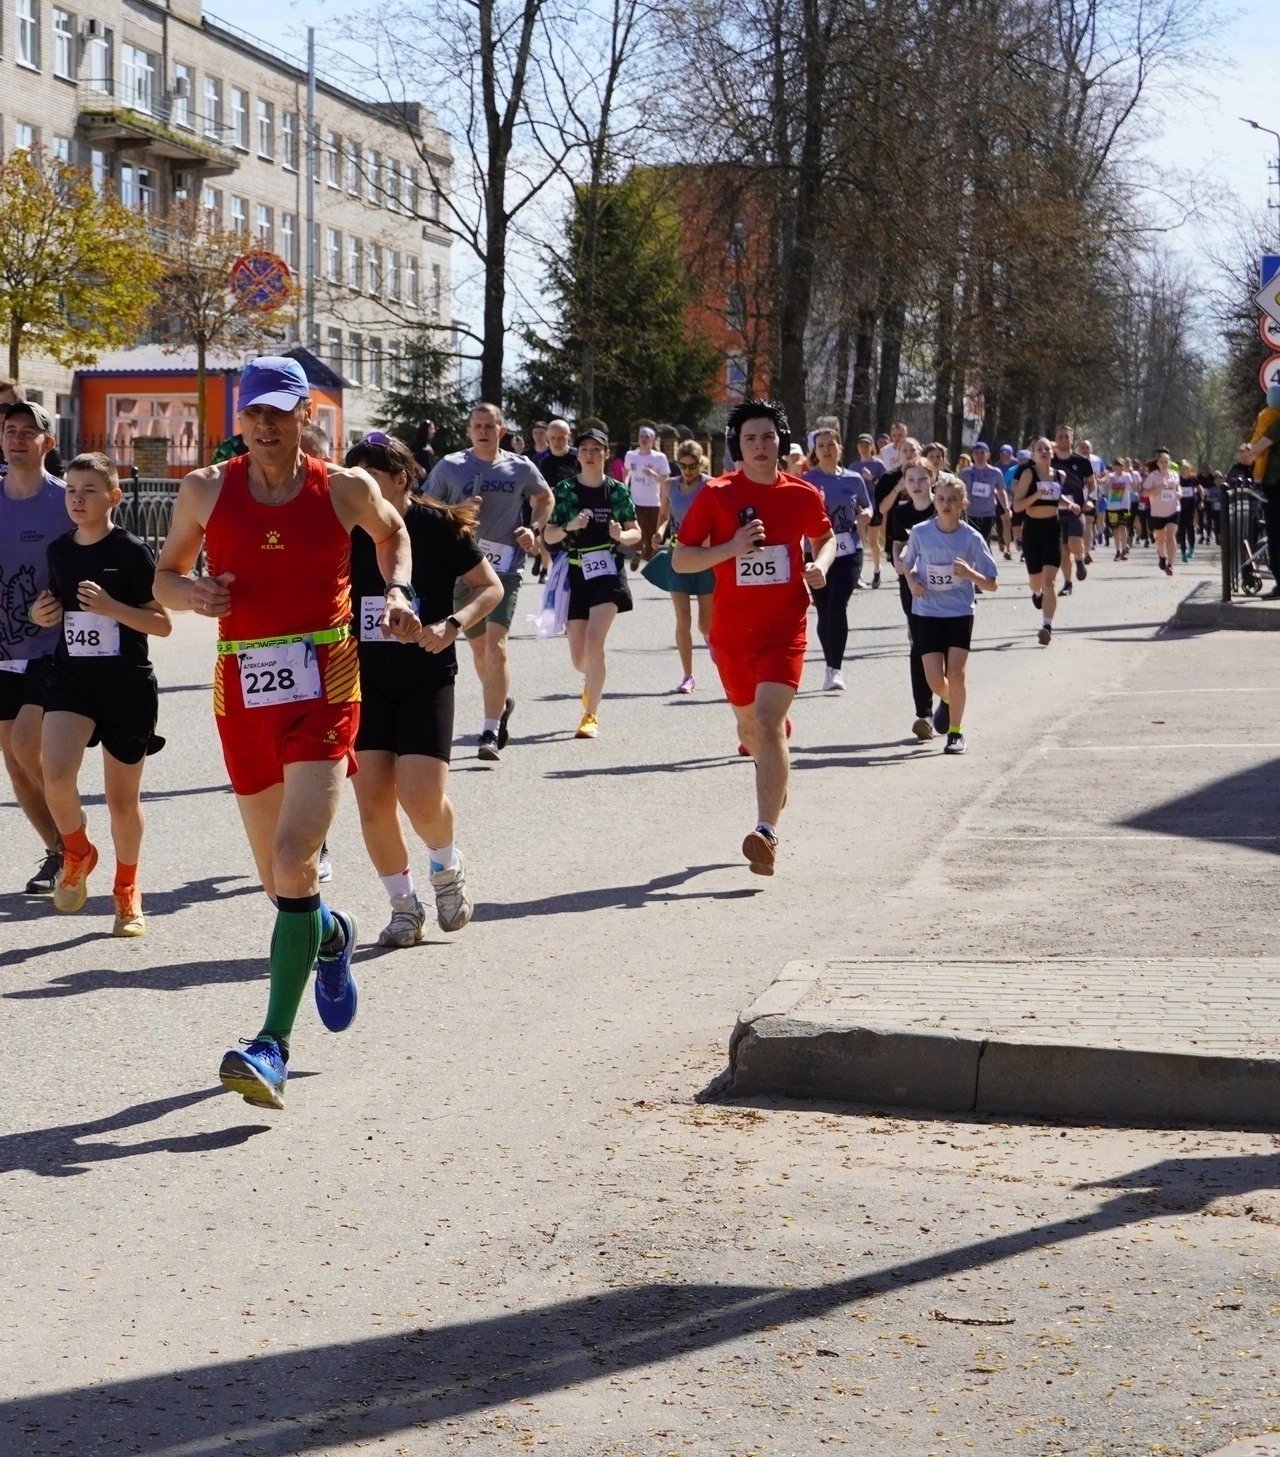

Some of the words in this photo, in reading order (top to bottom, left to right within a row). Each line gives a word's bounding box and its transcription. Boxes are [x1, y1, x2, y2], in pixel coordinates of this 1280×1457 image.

[480, 480, 516, 493] asics
[483, 551, 502, 566] 02
[584, 559, 607, 573] 329
[740, 561, 776, 577] 205
[929, 575, 953, 585] 332
[66, 629, 101, 647] 348
[243, 660, 278, 670] АЛЕКСАНДР
[244, 668, 295, 694] 228
